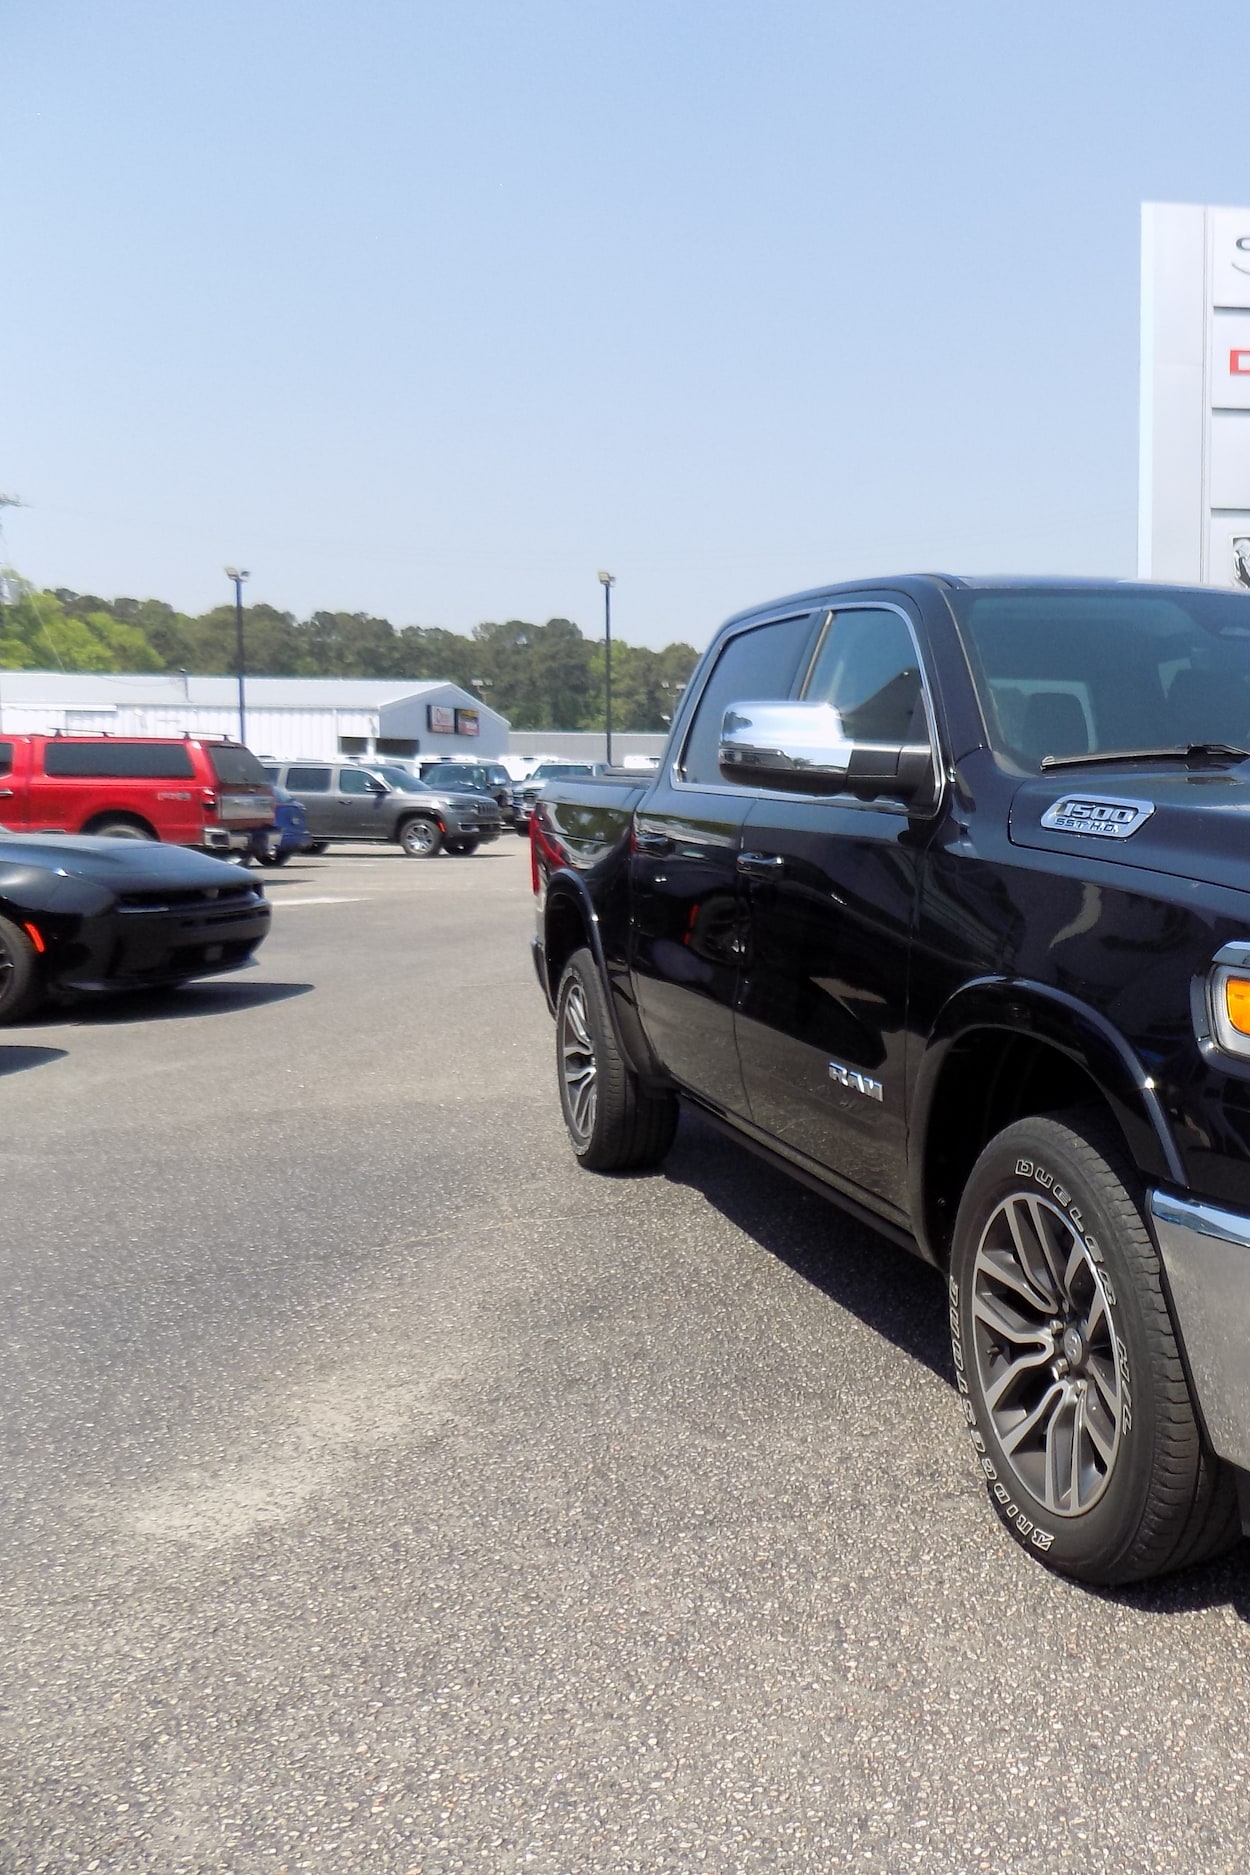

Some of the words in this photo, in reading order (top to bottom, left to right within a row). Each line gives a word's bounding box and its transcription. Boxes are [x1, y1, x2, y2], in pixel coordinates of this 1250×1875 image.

[1055, 817, 1088, 829] SST
[1063, 803, 1135, 824] 1500
[828, 1061, 884, 1103] RAM
[1014, 1158, 1117, 1307] DUELER
[949, 1274, 1056, 1552] BRIDGESTONE
